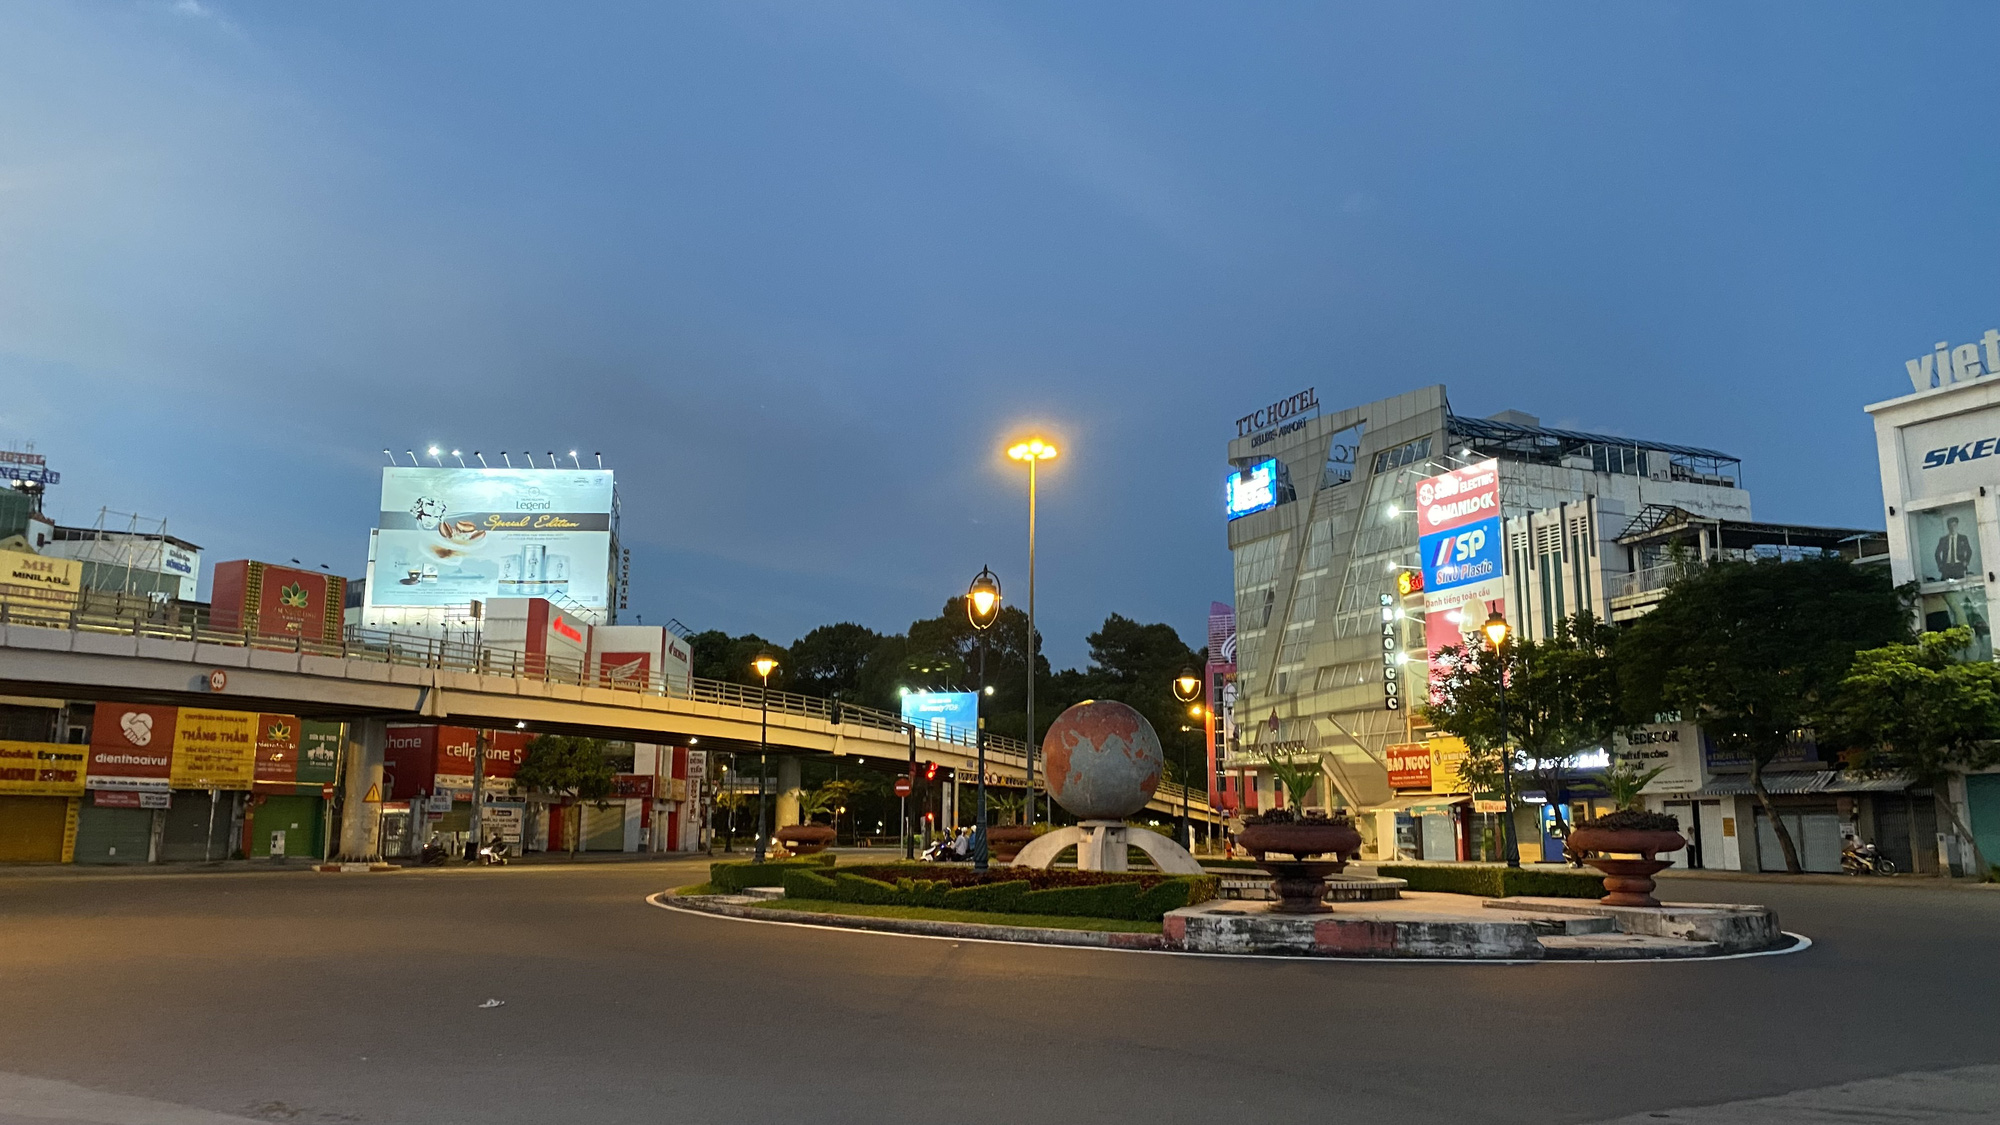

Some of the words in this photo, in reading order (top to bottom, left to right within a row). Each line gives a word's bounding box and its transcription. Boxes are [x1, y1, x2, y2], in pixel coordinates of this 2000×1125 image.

[1236, 409, 1264, 436] TTC
[1267, 387, 1319, 425] HOTEL
[1279, 417, 1307, 438] AIRPORT
[1460, 473, 1494, 494] ELECTRIC
[516, 500, 550, 511] Legend
[484, 514, 531, 531] Special
[533, 514, 580, 529] Edition
[1456, 529, 1486, 562] SP
[21, 559, 53, 573] MH
[1460, 559, 1493, 581] Plastic
[12, 571, 61, 584] MINILAB
[1425, 596, 1442, 608] Danh
[1444, 593, 1460, 606] tiếng
[1462, 590, 1478, 601] toàn
[1479, 586, 1490, 597] cầu
[384, 735, 421, 748] hone
[95, 753, 167, 766] dienthoaivui
[446, 742, 510, 762] cellpone
[1405, 755, 1430, 775] NGỌC
